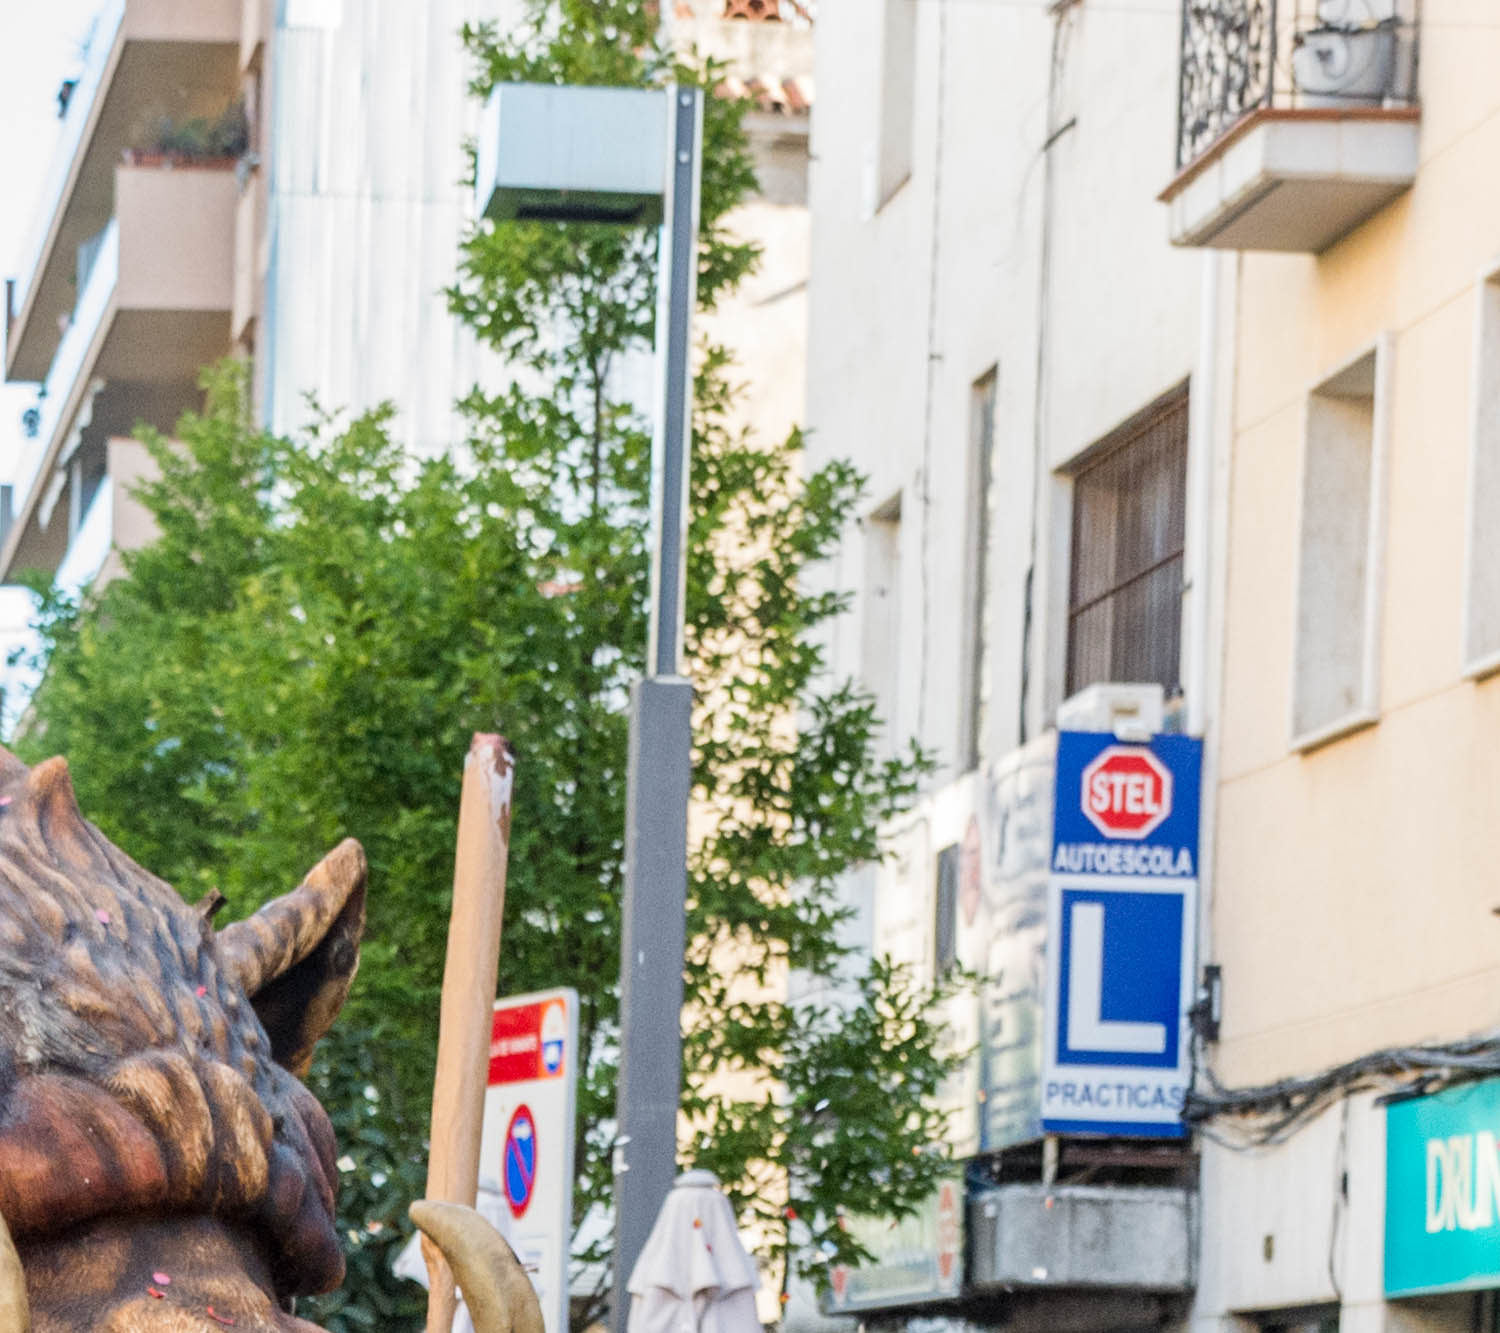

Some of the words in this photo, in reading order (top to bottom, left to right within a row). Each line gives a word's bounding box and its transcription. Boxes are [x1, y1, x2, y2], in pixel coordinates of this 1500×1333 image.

[1090, 772, 1160, 814] STEL
[1054, 843, 1193, 875] AUTOESCOLA
[1066, 901, 1167, 1054] L
